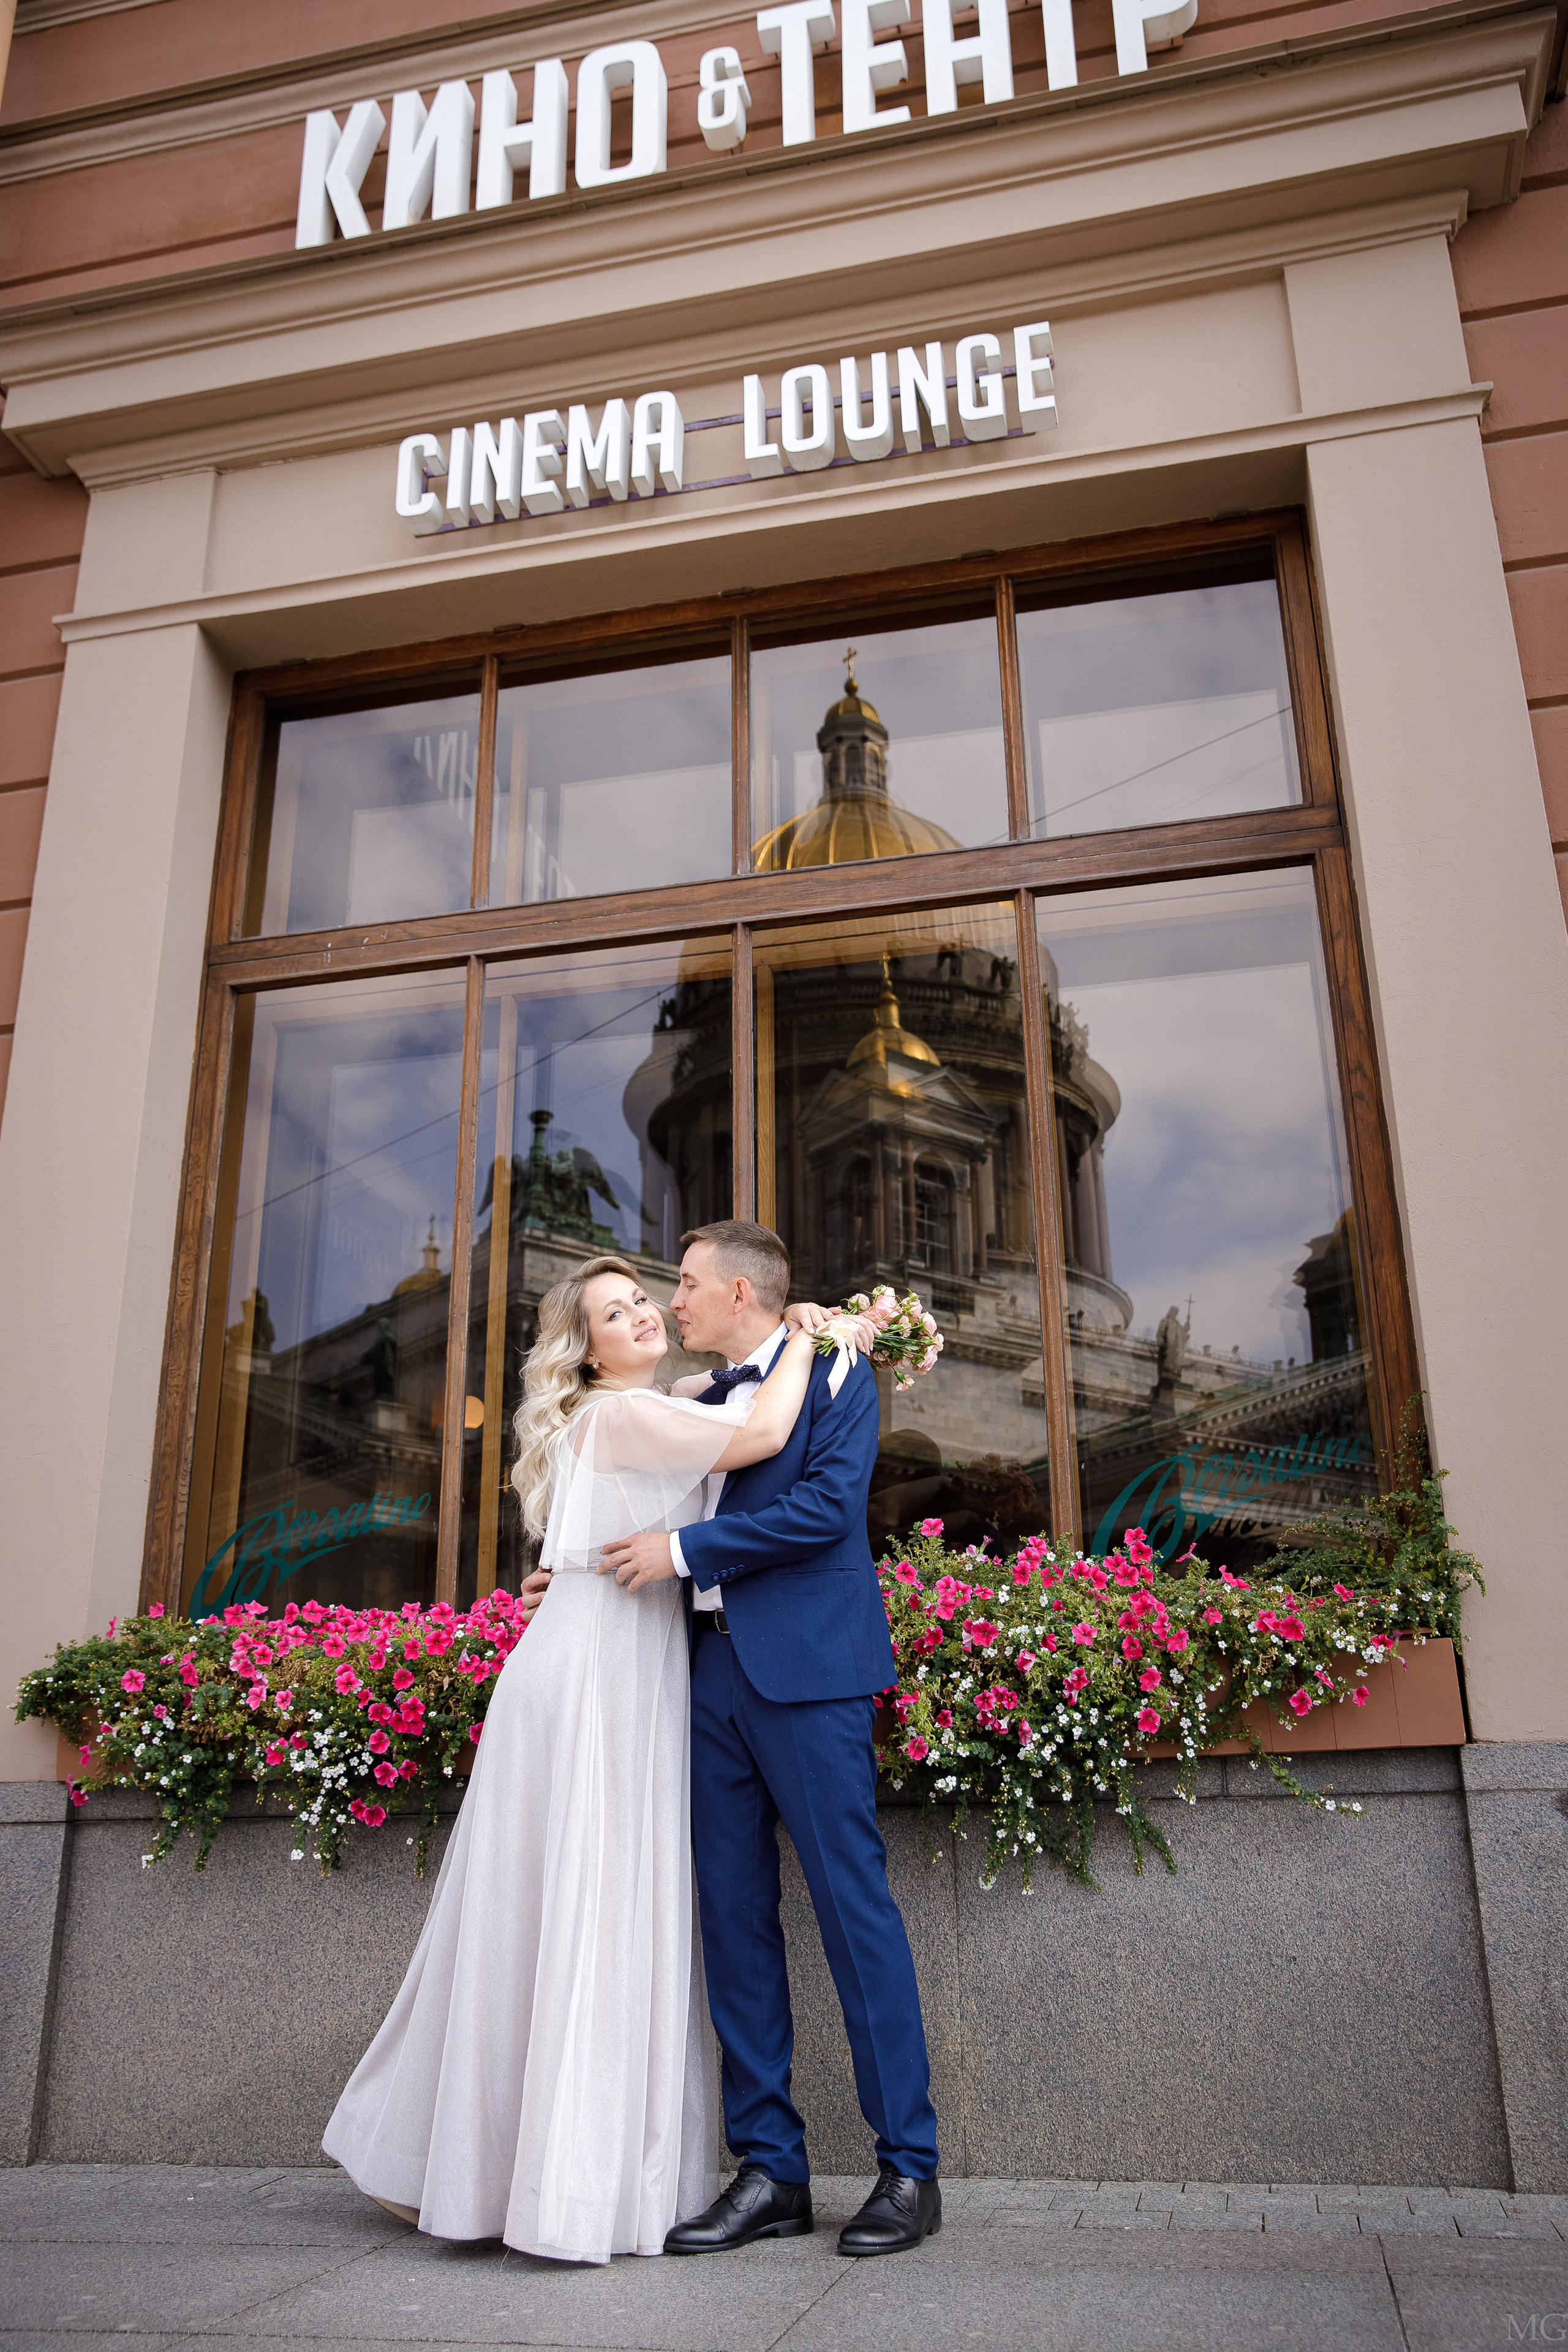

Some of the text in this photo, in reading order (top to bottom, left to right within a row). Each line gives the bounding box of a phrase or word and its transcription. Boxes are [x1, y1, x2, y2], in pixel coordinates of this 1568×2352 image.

[295, 40, 668, 250] КИНО
[697, 46, 752, 151] &
[395, 321, 1058, 535] CINEMA LOUNGE
[189, 1490, 431, 1626] Borsalino
[1091, 1431, 1371, 1566] Borsalino
